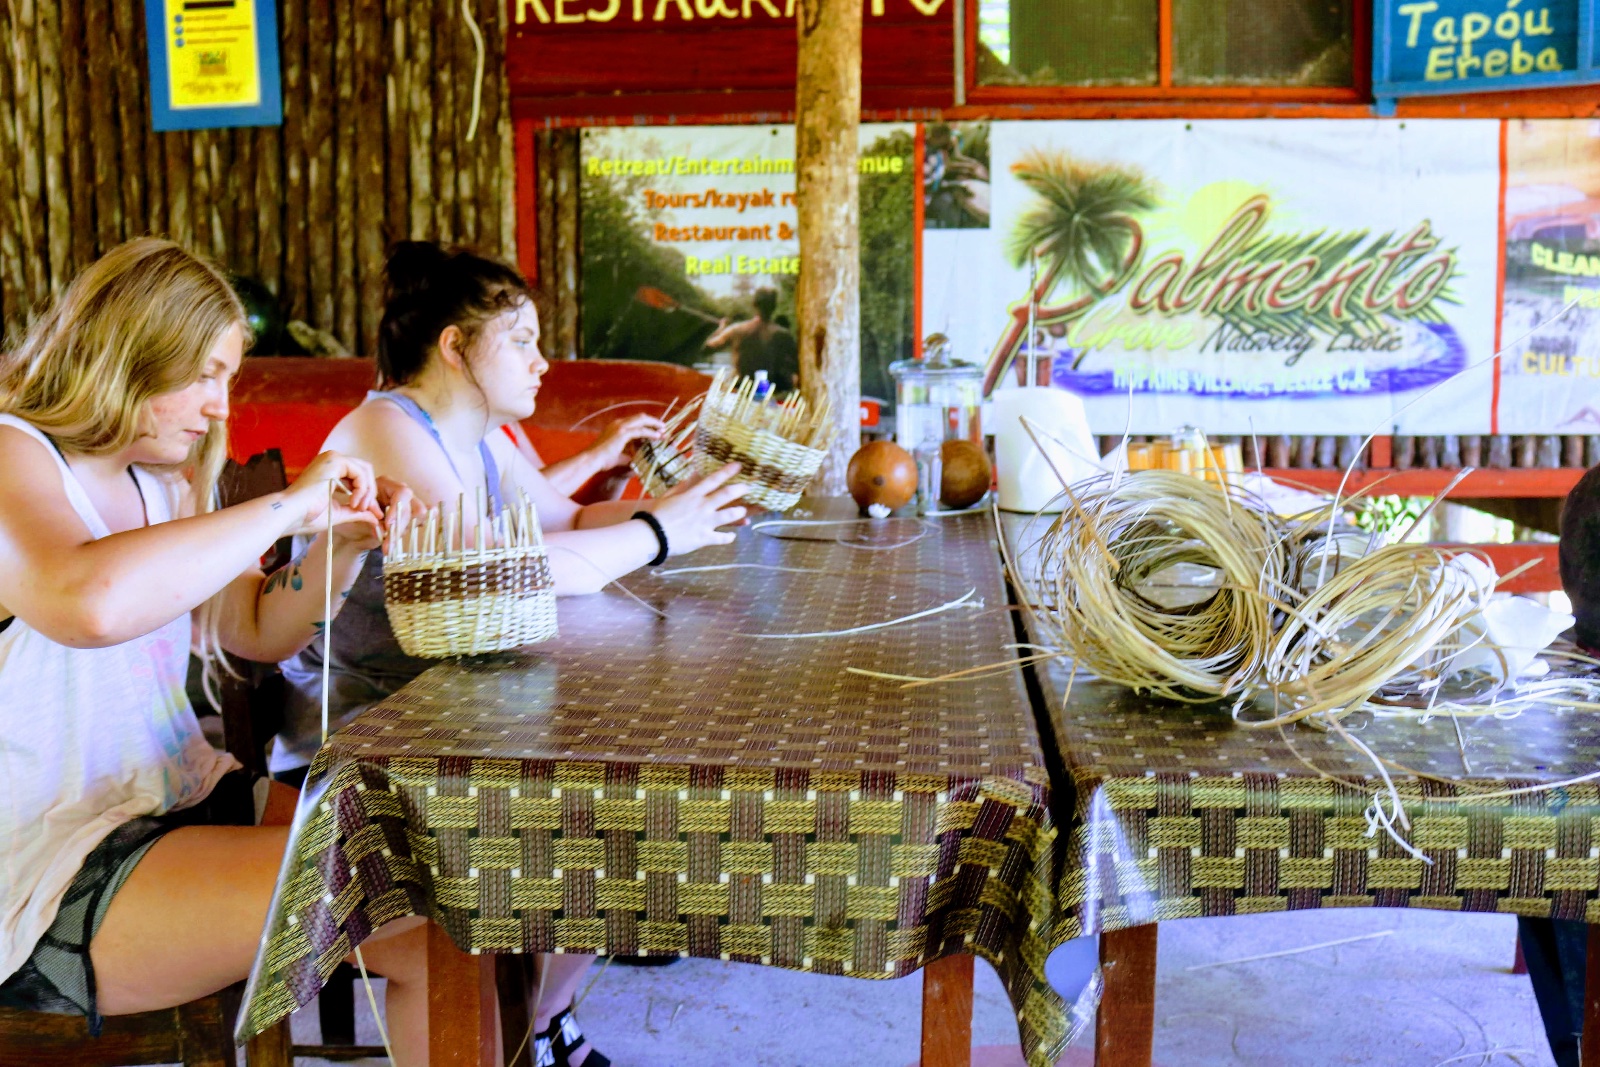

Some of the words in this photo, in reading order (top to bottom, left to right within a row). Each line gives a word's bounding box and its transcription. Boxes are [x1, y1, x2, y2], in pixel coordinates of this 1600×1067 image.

[1424, 39, 1564, 82] Ereba
[643, 187, 775, 214] Tours/kayak
[653, 221, 772, 242] Restaurant
[776, 221, 794, 241] &
[685, 254, 733, 276] Real
[736, 254, 801, 276] Estate
